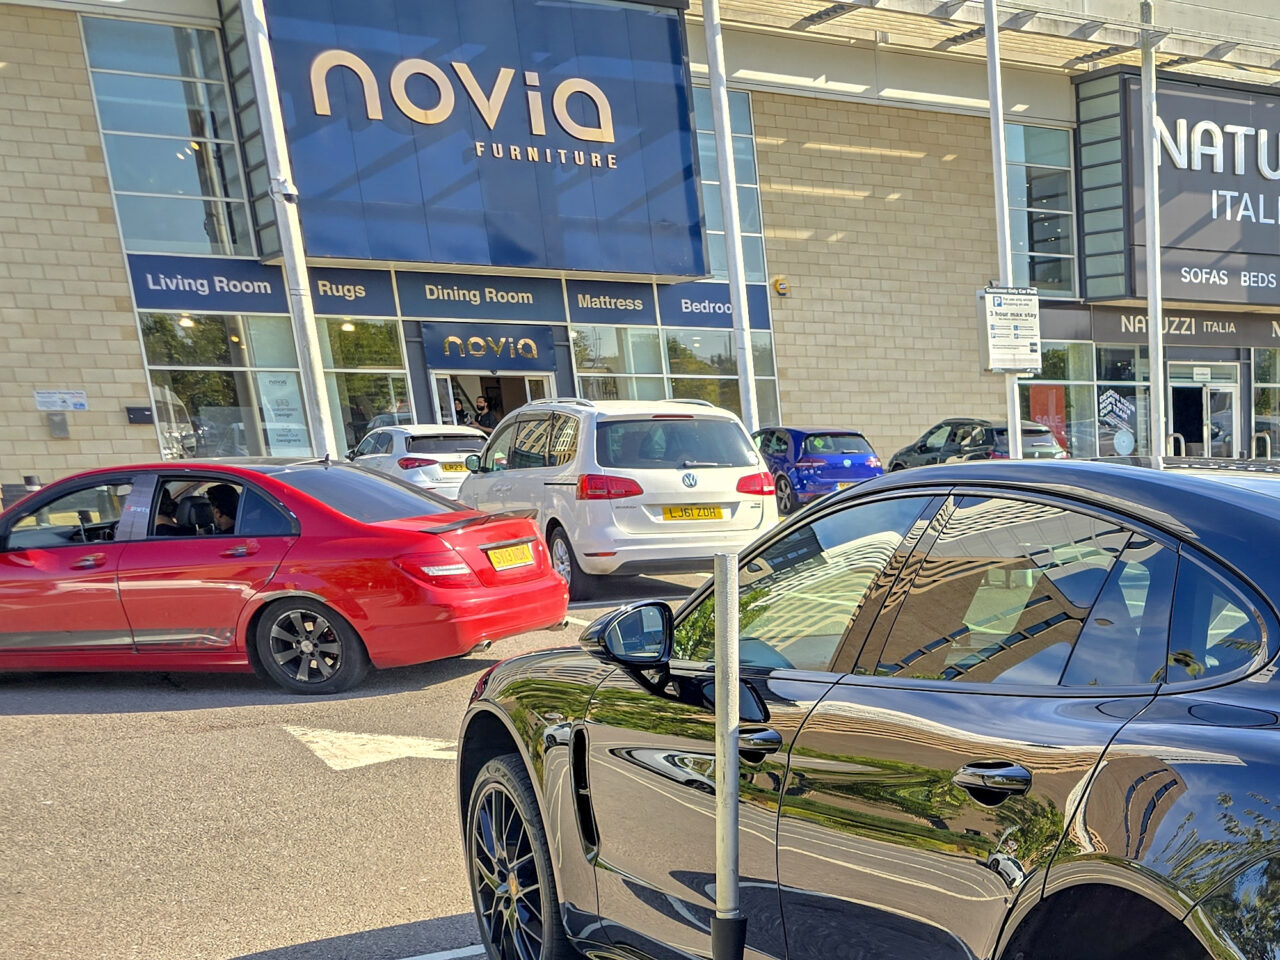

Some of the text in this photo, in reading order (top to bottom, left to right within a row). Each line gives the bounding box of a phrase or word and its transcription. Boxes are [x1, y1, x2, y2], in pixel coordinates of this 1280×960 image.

[310, 49, 615, 143] novia
[475, 141, 618, 169] FURNITURE
[146, 273, 272, 296] Living Room
[1180, 266, 1229, 286] SOFAS
[1240, 272, 1277, 288] BEDS
[317, 280, 366, 301] Rugs
[424, 285, 533, 306] Dining Room
[577, 293, 644, 311] Mattress
[681, 299, 732, 315] Bedroo
[1121, 315, 1236, 335] NAUZZI ITALIA
[443, 335, 538, 359] novia
[1035, 415, 1062, 426] SALE
[669, 507, 694, 518] LJ61
